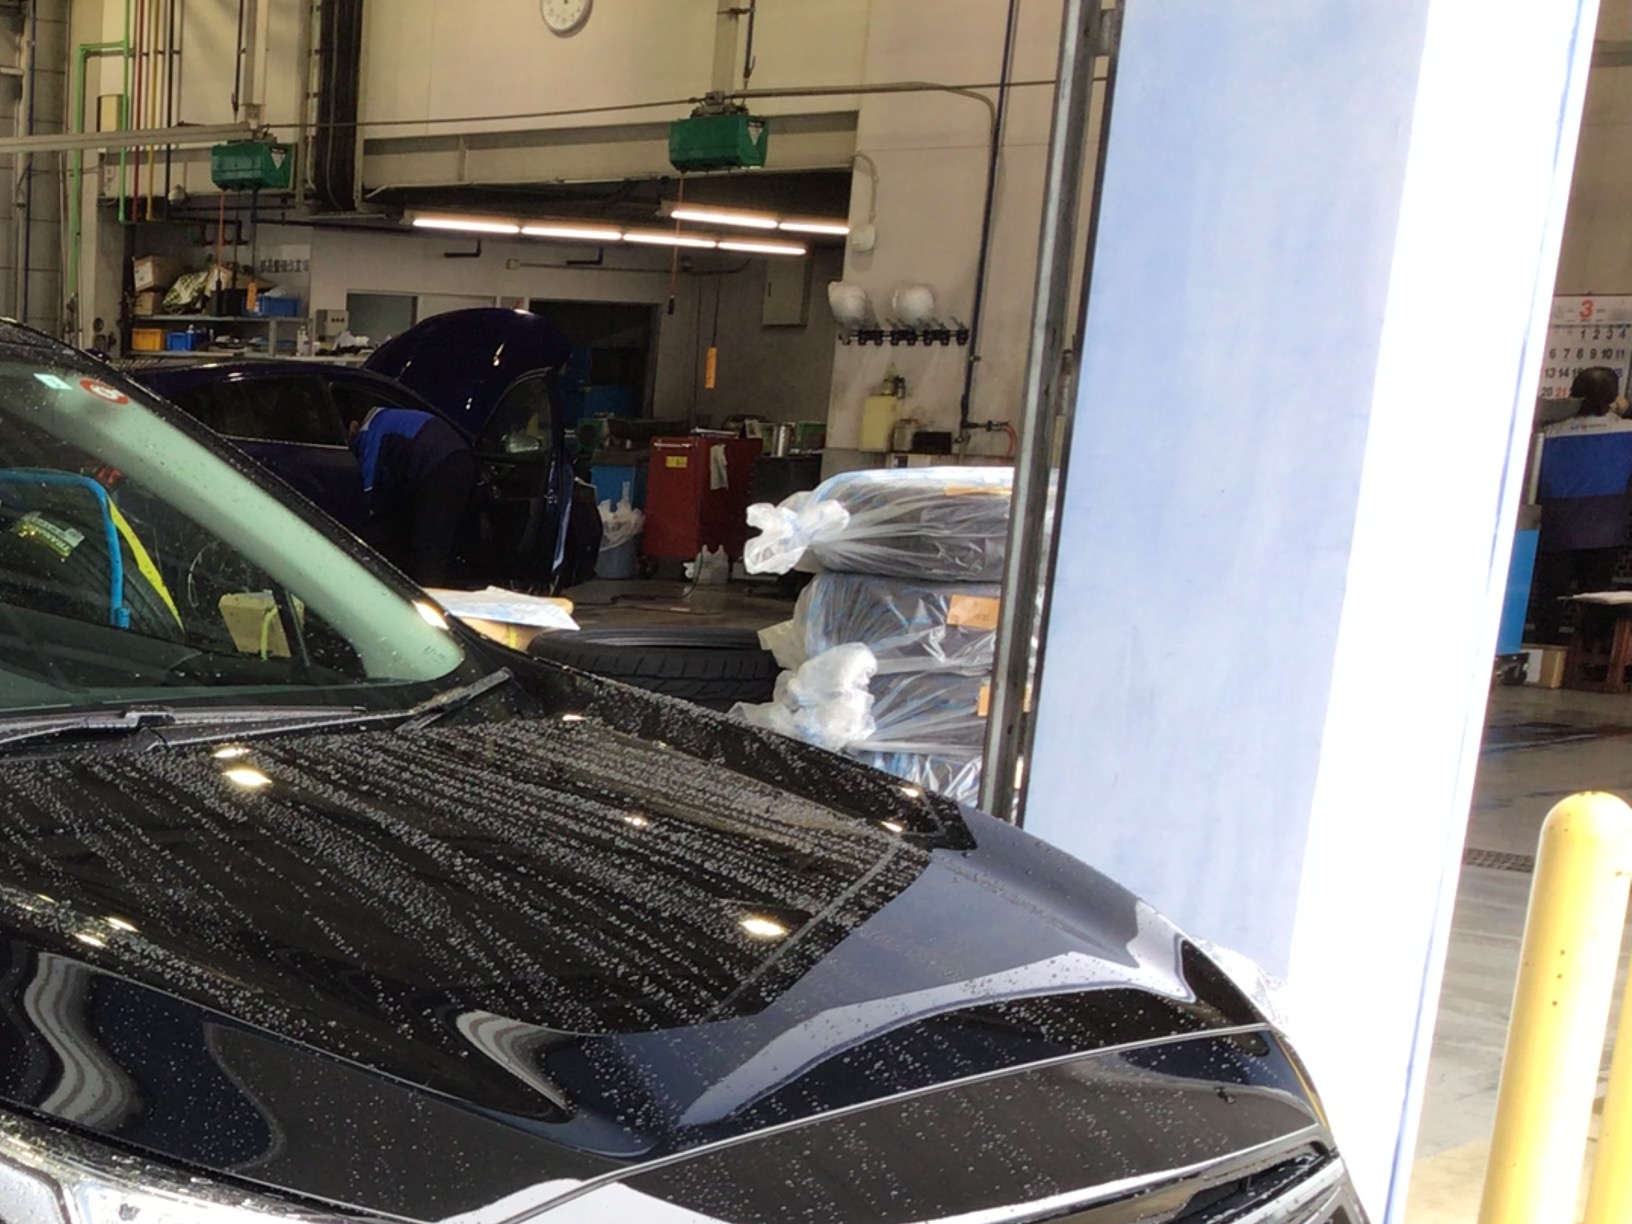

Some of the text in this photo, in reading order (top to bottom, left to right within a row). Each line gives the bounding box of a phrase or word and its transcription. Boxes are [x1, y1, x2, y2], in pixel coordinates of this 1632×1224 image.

[1579, 300, 1594, 319] 3
[1580, 328, 1627, 340] 1 2 3 4
[1549, 348, 1625, 360] 6 7 8 9 10 11
[1545, 368, 1556, 378] 13
[1558, 368, 1569, 378] 14
[1541, 387, 1553, 397] 20
